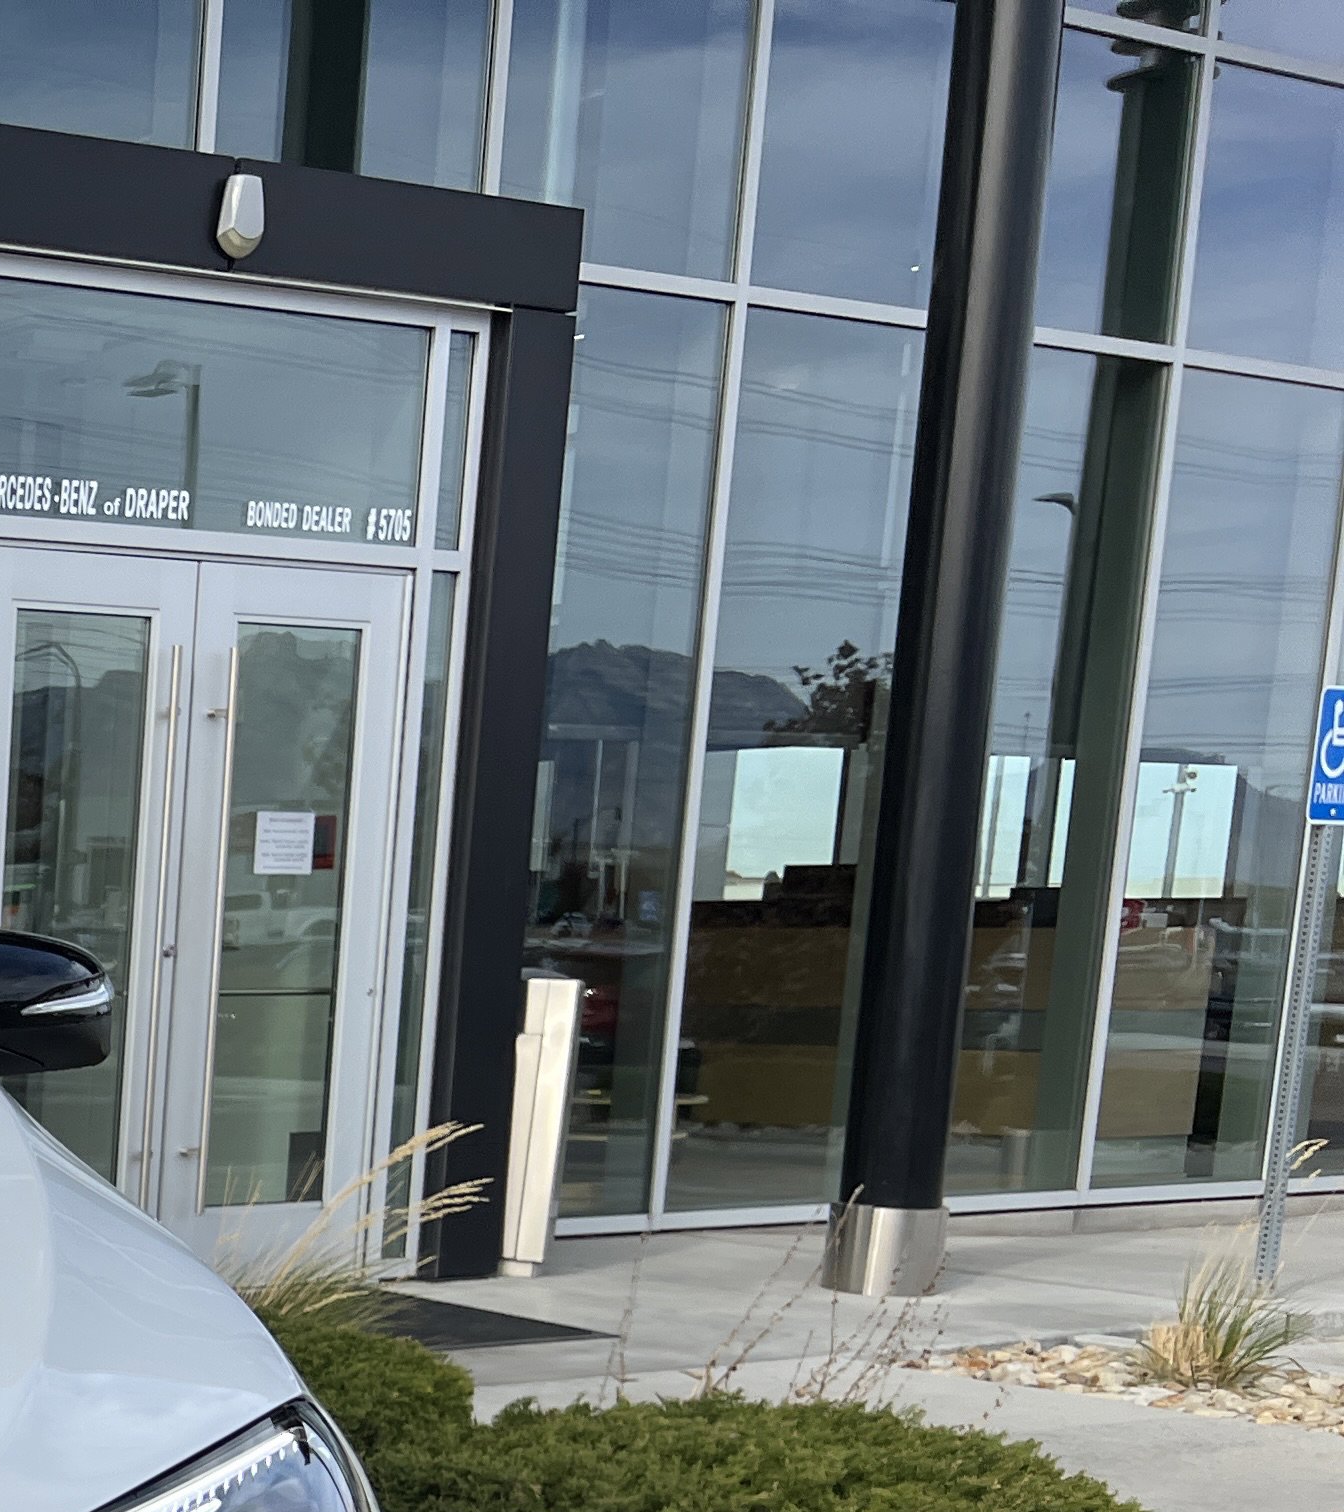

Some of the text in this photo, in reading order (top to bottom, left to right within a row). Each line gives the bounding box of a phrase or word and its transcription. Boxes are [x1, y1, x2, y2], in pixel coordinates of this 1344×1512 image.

[103, 497, 122, 516] of
[124, 487, 190, 521] DRAPER
[246, 500, 298, 529] BONDED
[302, 505, 352, 533] DEALER
